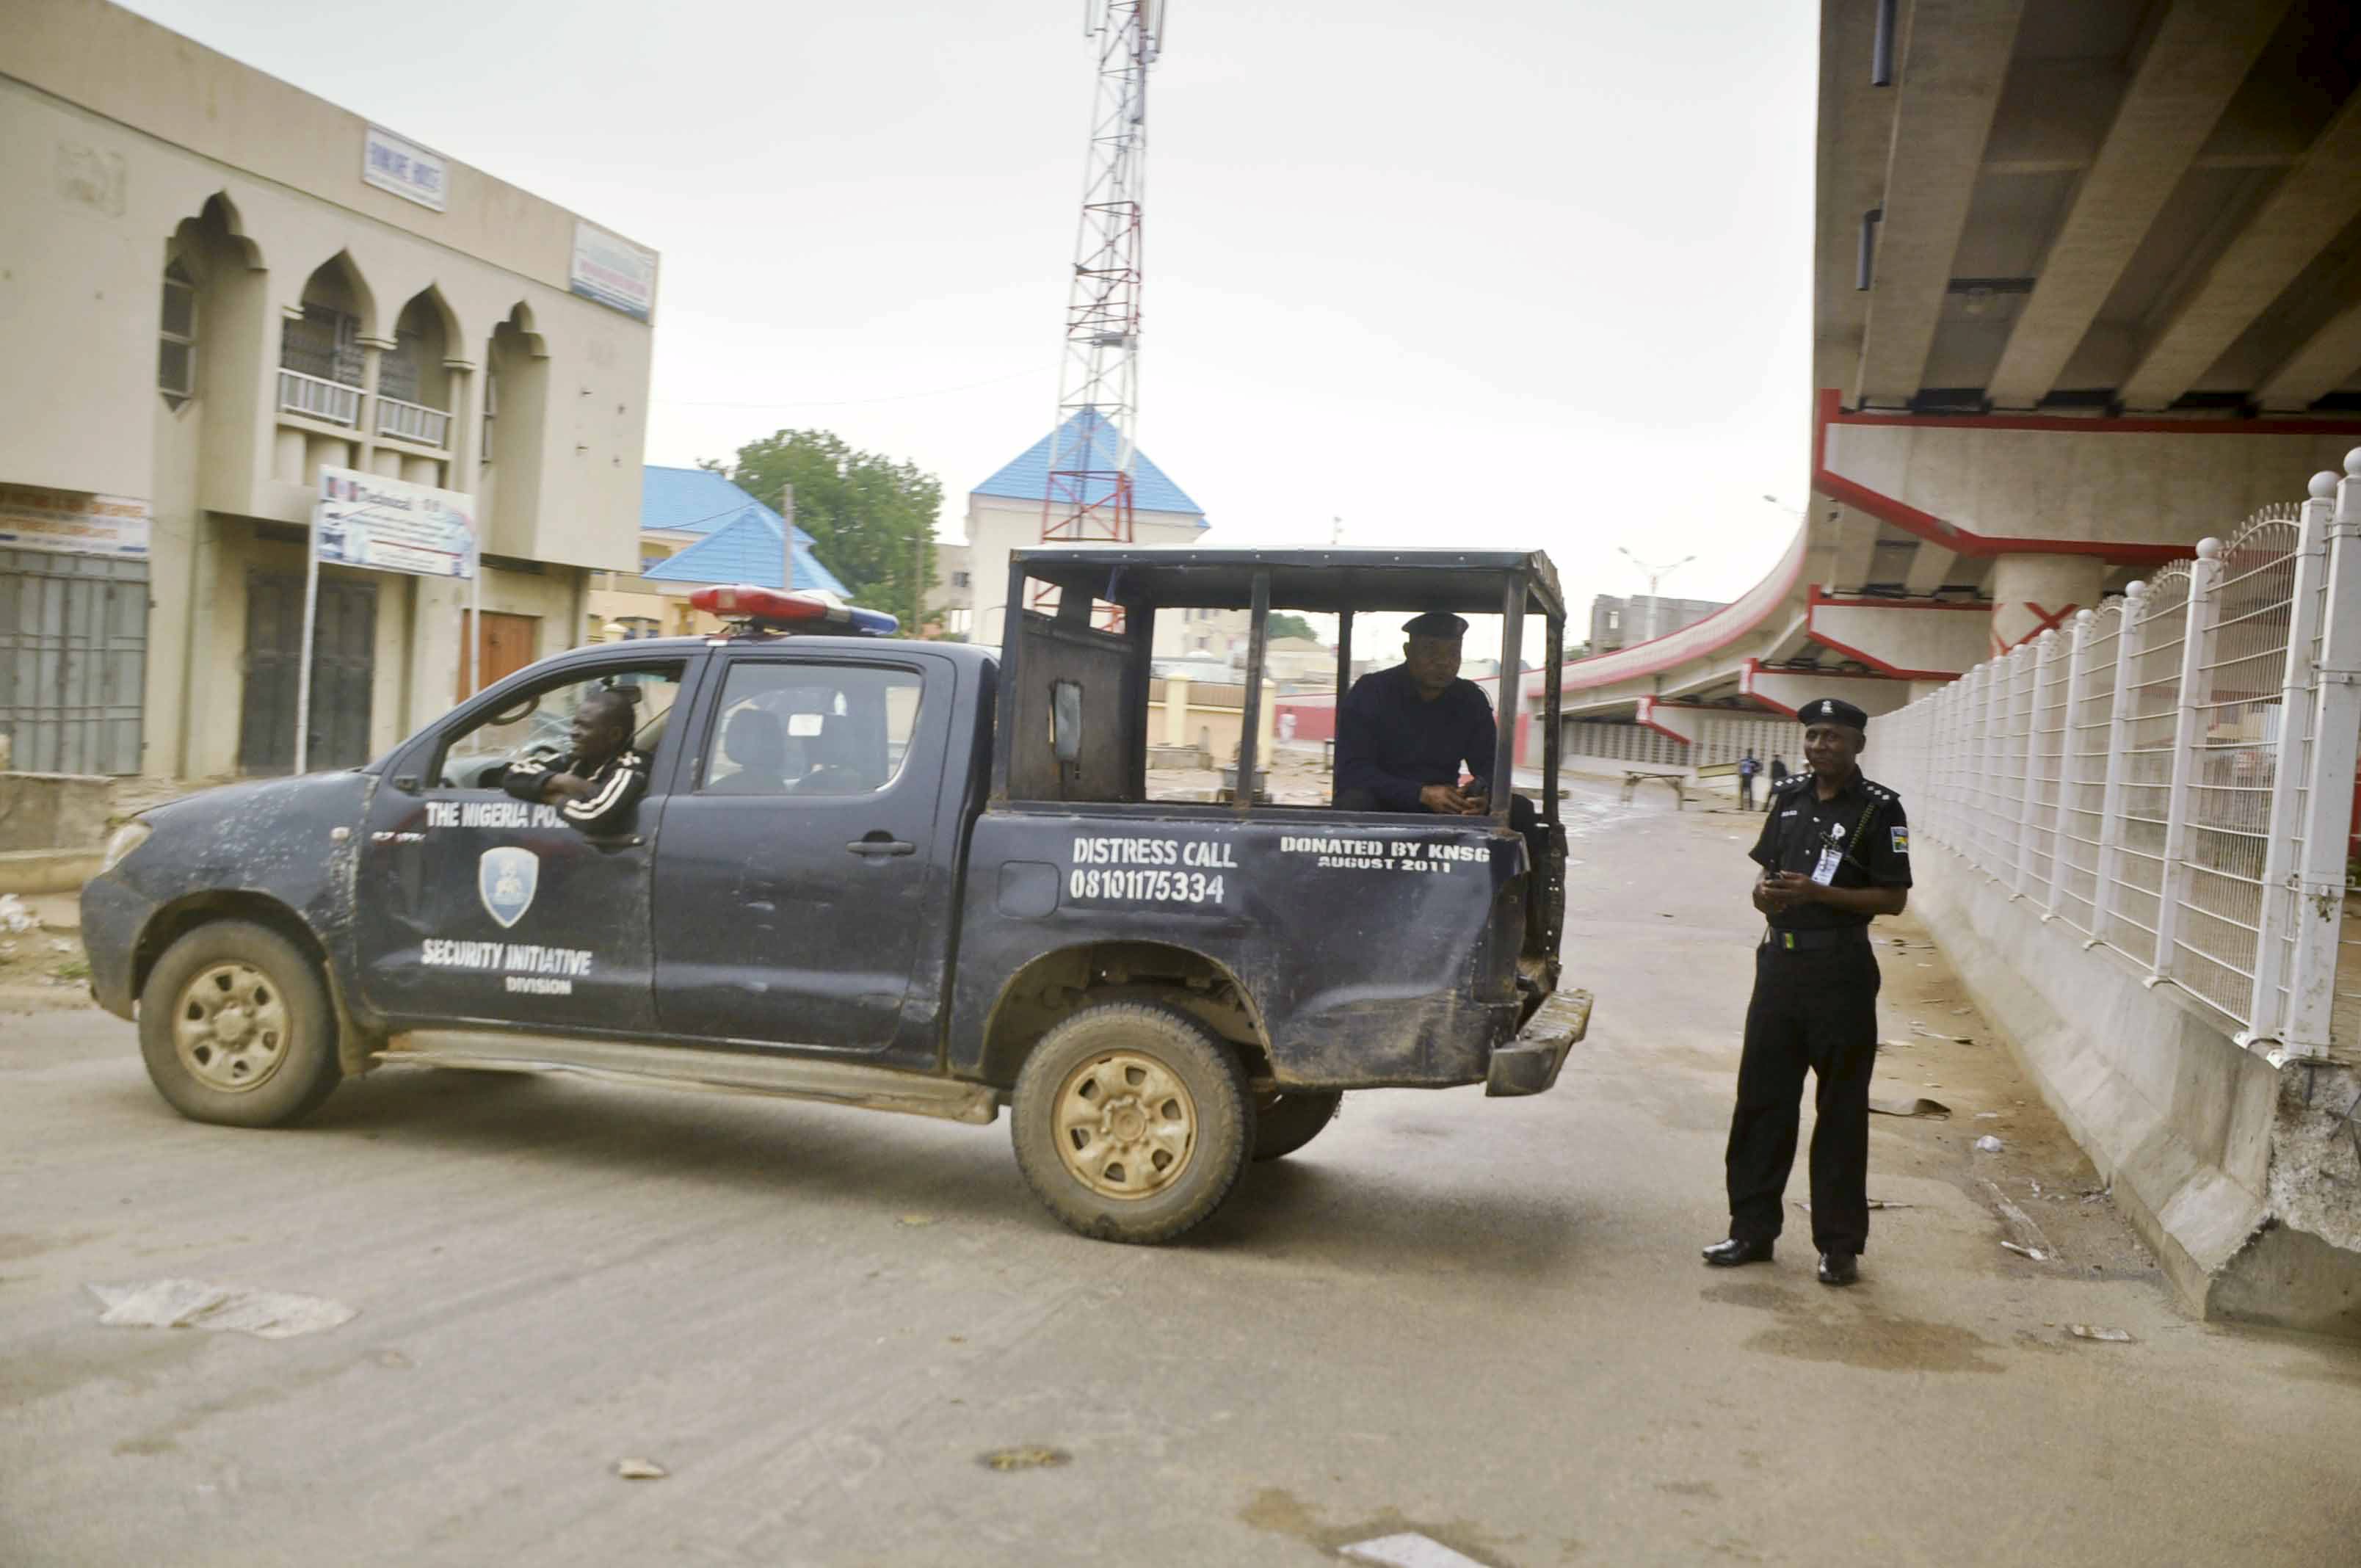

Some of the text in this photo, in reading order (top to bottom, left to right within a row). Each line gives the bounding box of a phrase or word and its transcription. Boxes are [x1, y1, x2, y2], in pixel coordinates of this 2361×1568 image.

[425, 801, 570, 829] THE NIGERIA POL
[1073, 837, 1238, 868] DISTRESS CALL
[1280, 836, 1491, 863] DONATED BY KNSG
[1318, 856, 1451, 874] AUGUST 2011
[1069, 868, 1225, 904] 08101175334
[421, 938, 592, 976] SECURITY INITIATIVE
[505, 976, 572, 995] DIVISION
